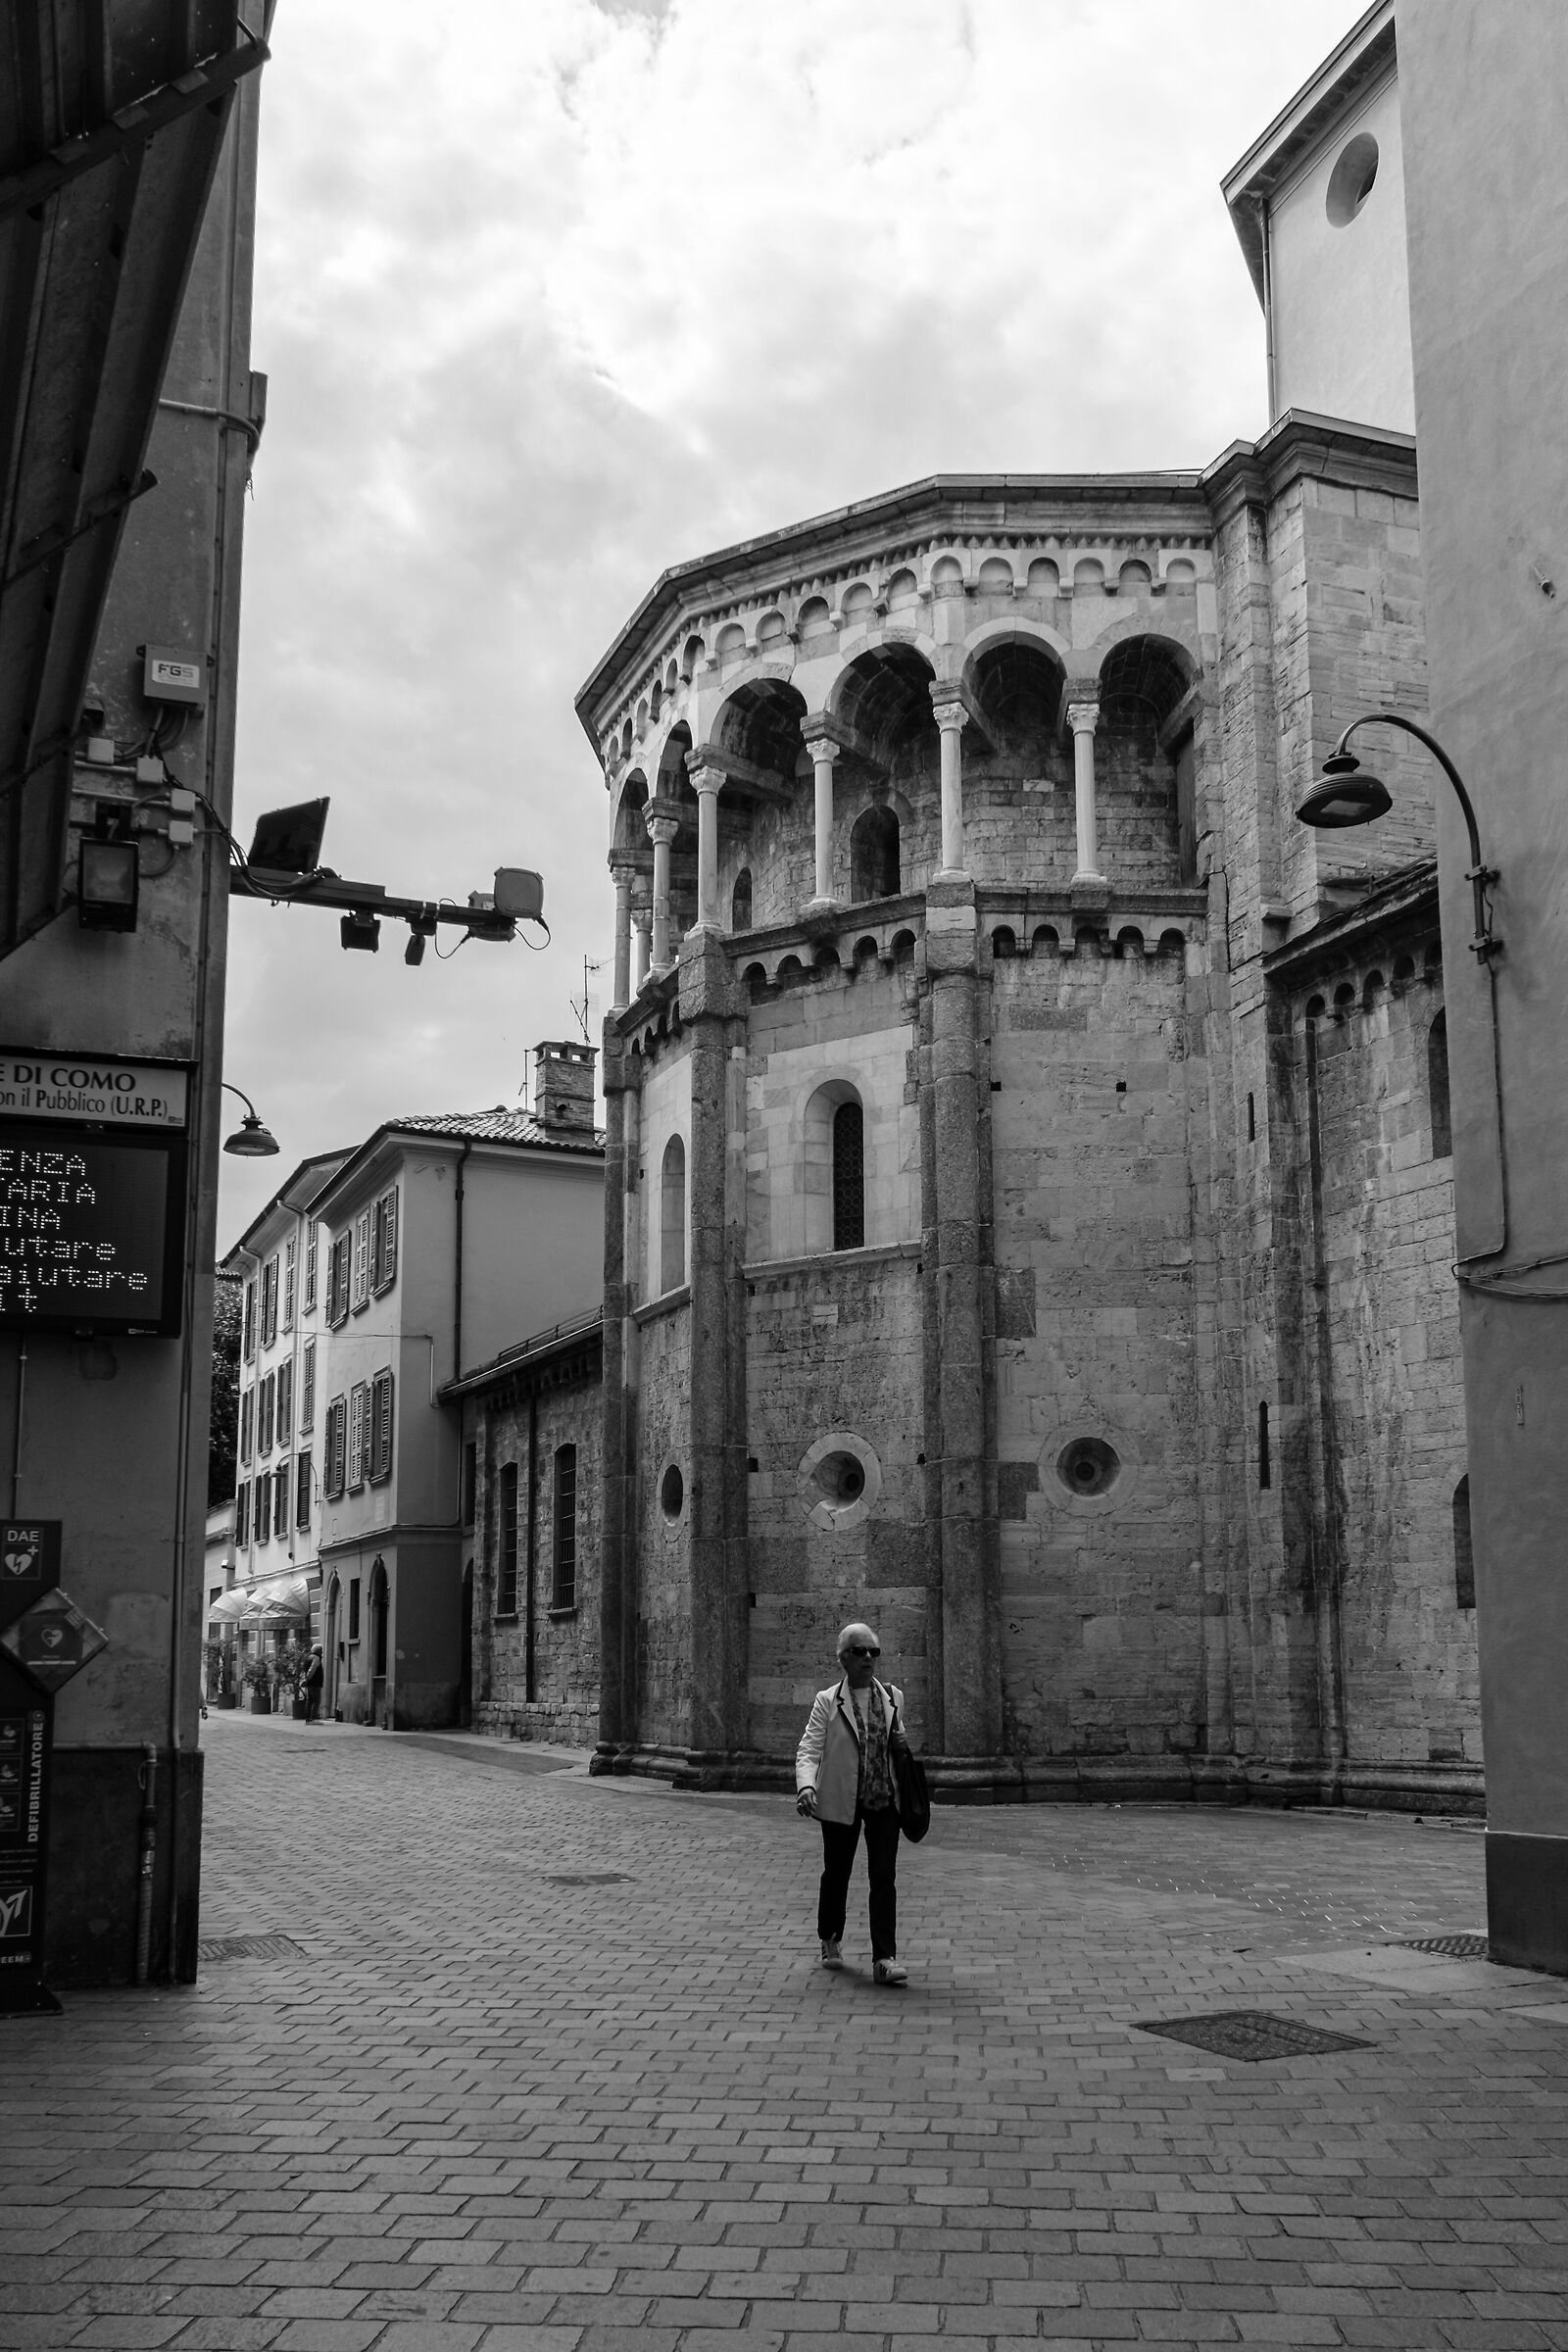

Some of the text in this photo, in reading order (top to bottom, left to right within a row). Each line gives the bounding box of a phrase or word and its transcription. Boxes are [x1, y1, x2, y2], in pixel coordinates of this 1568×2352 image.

[158, 662, 194, 678] FGS
[14, 1064, 42, 1086] DI
[50, 1068, 136, 1093] COMO
[22, 1088, 31, 1107] il
[36, 1090, 105, 1113] Pubblico
[111, 1096, 168, 1120] (U.R.P.)
[0, 1150, 86, 1176] ENZA
[0, 1177, 96, 1204] ARIA
[7, 1530, 40, 1543] DAE
[27, 1723, 44, 1842] DEFIBRILLATORE
